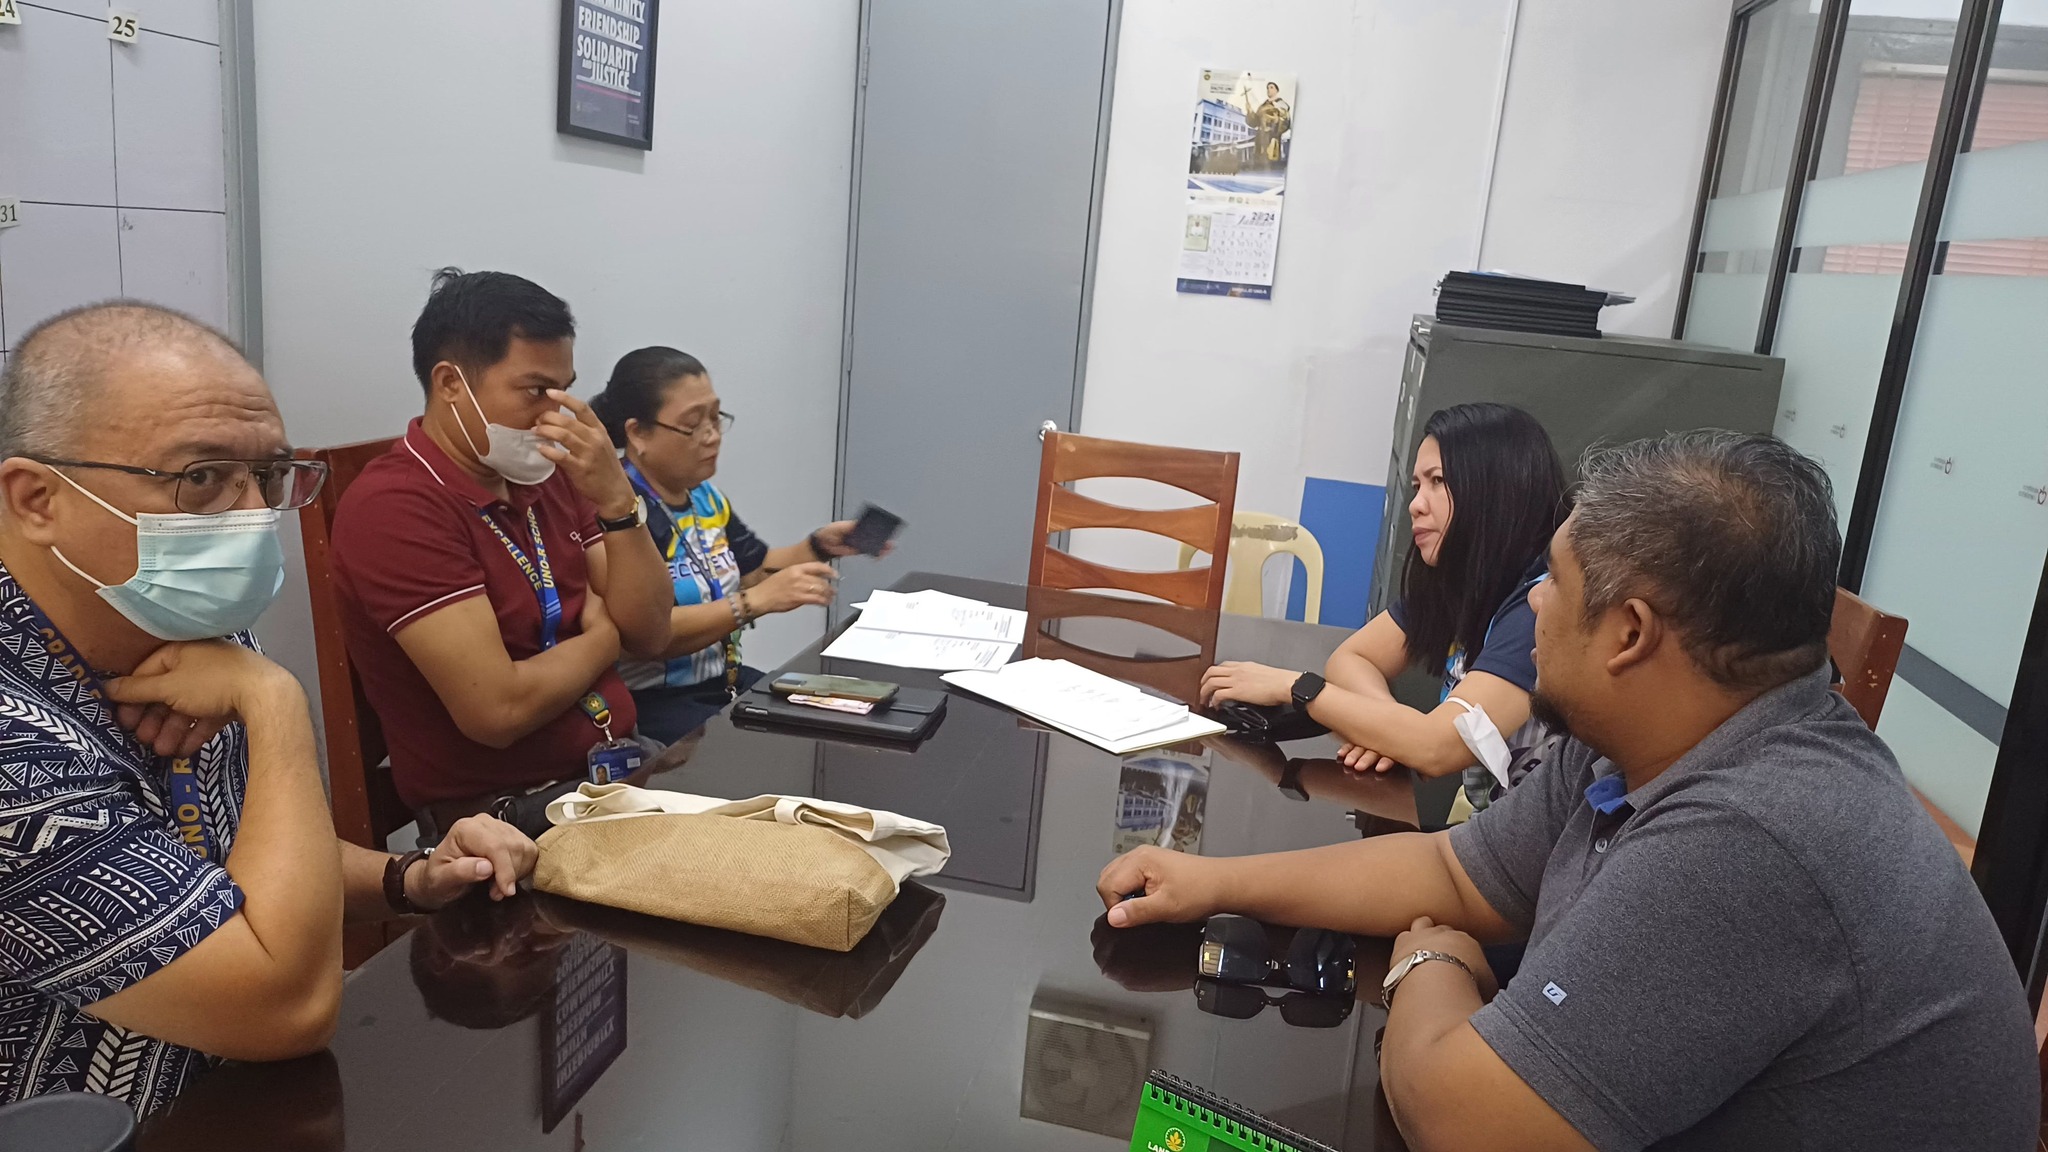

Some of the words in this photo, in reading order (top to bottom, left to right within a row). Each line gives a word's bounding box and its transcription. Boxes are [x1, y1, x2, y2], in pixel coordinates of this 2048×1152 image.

[112, 16, 136, 38] 25
[578, 5, 641, 45] FRIENDSHIP
[583, 0, 645, 21] UNITY
[576, 34, 639, 74] SOLIDARITY
[590, 60, 631, 90] JUSTICE
[0, 204, 18, 223] 31
[526, 505, 544, 547] SCHO
[481, 514, 543, 591] EXCELLENCE
